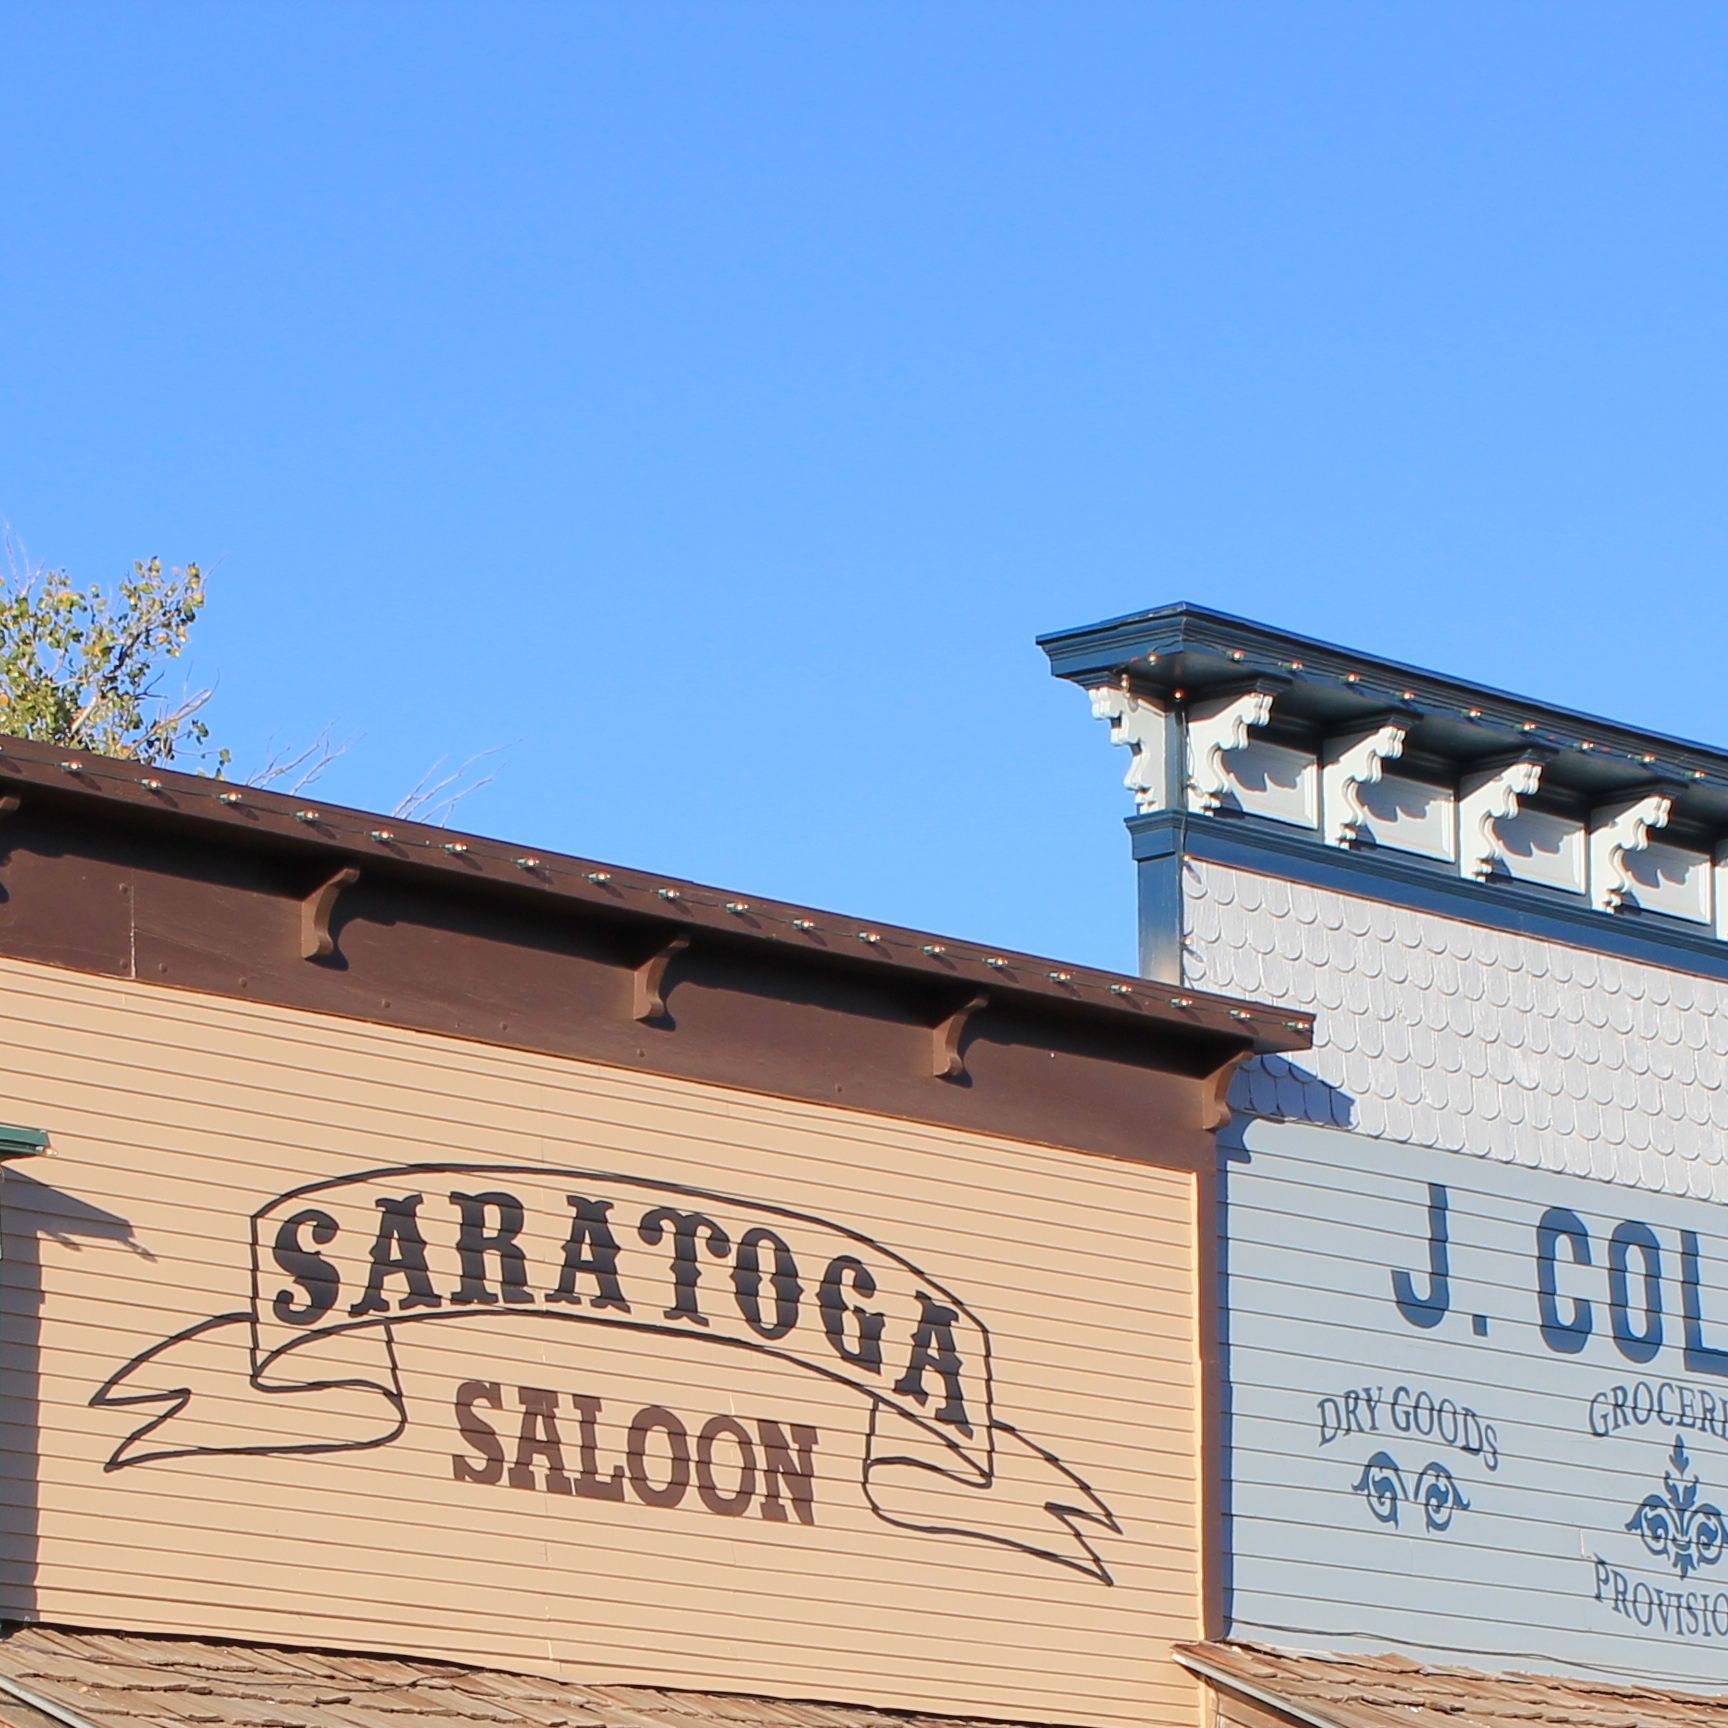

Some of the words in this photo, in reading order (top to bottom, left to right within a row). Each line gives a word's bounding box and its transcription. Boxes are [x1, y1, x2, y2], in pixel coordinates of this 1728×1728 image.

[273, 1191, 974, 1438] SARATOGA
[1391, 1182, 1489, 1336] J.
[451, 1381, 817, 1526] SALOON
[1317, 1386, 1384, 1448] DRY
[1391, 1386, 1499, 1472] GOODS
